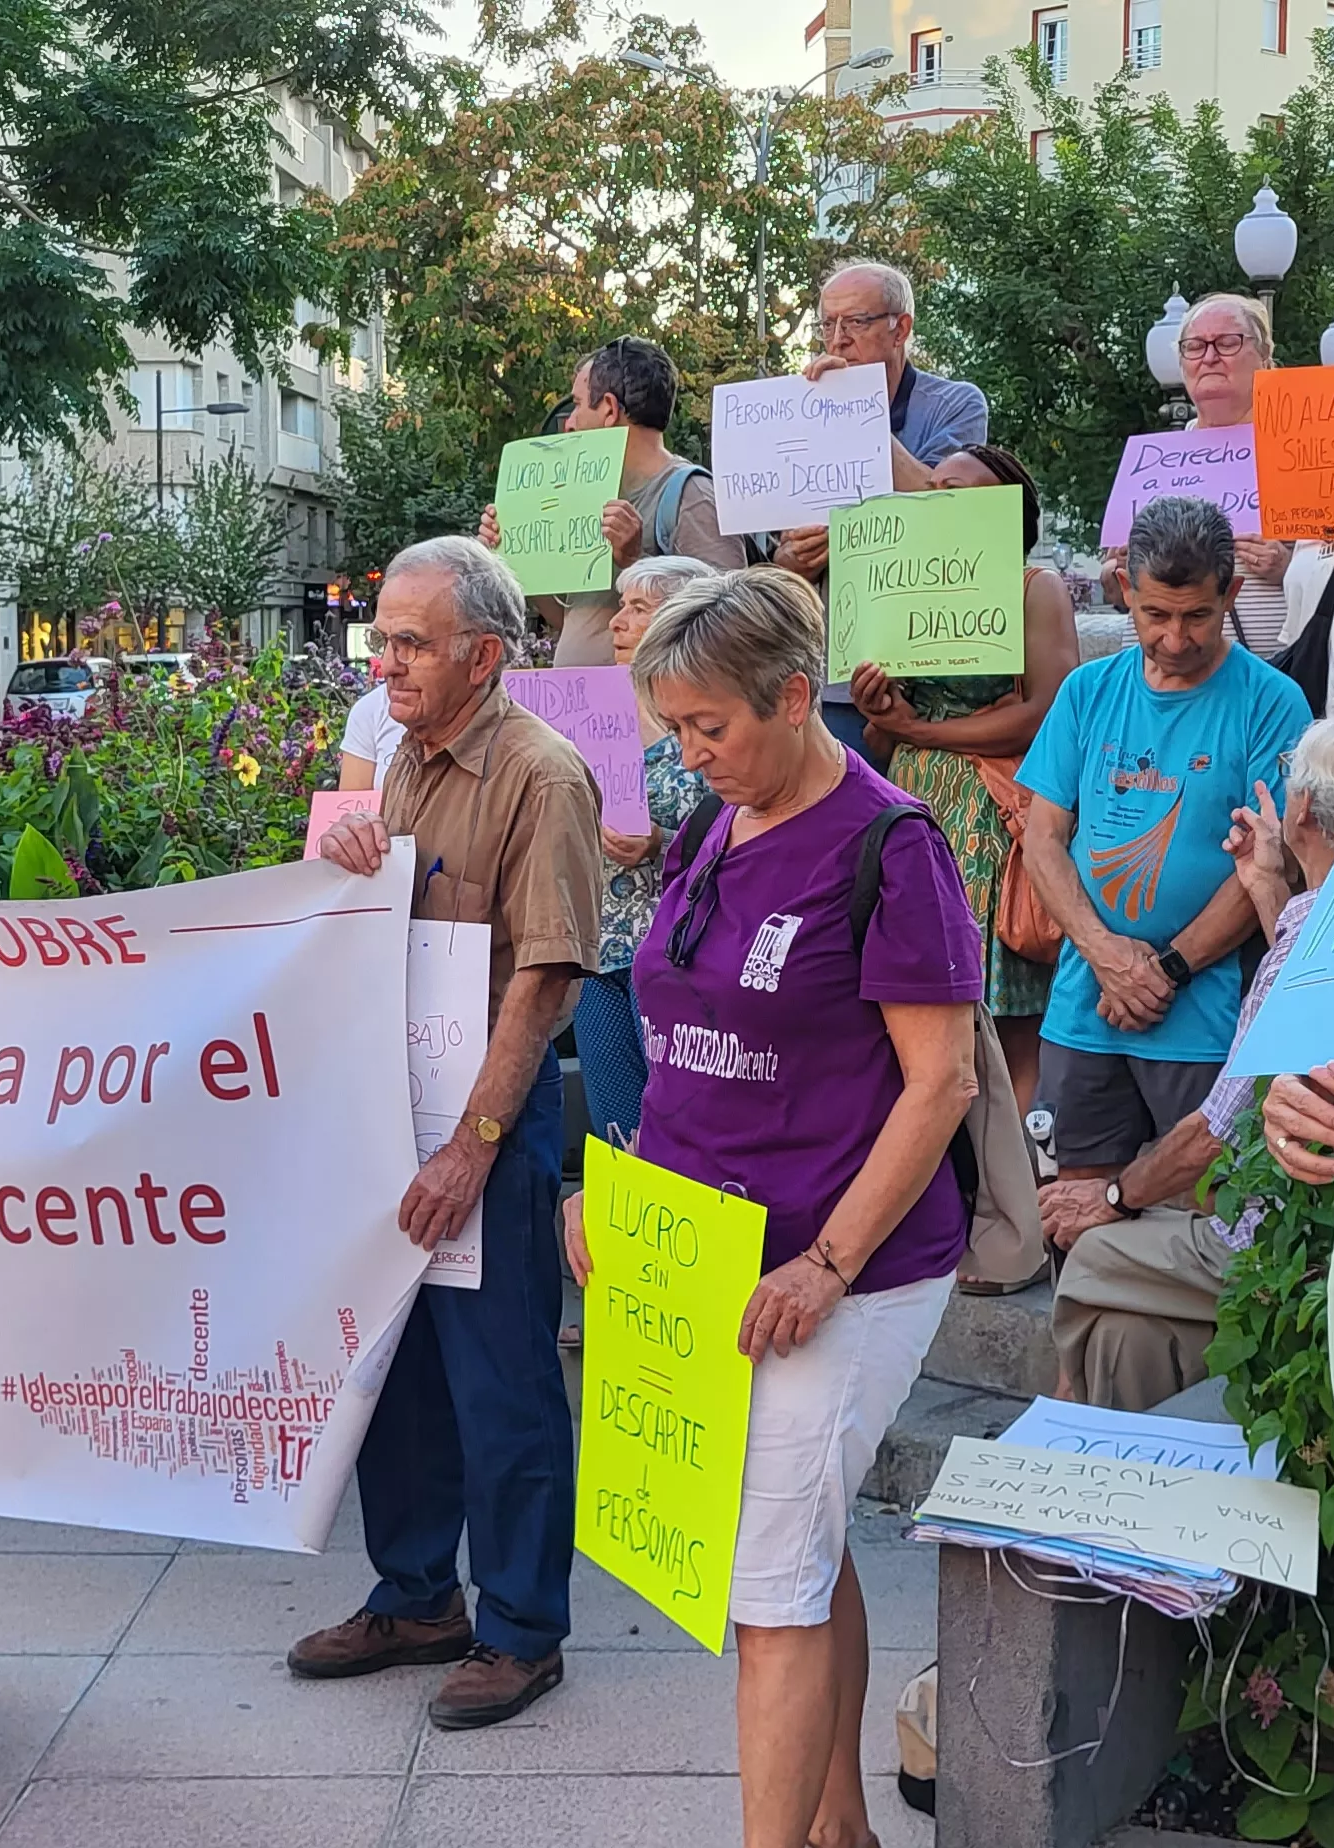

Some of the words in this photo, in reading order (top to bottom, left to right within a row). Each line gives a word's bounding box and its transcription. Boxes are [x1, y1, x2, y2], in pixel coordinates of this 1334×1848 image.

[725, 394, 794, 429] PERSONAS
[801, 387, 886, 427] COMPROMETIDAS
[1299, 396, 1313, 430] A
[506, 462, 545, 492] LUCRO
[574, 450, 611, 484] FRENO
[1130, 441, 1252, 476] Derecho
[722, 471, 780, 500] TRABAJO
[1143, 478, 1159, 490] a
[1171, 474, 1205, 487] una
[503, 519, 555, 555] DESCARTE
[839, 511, 905, 552] DIGNIDAD
[868, 548, 984, 592] INCLUSIÓN
[908, 605, 1007, 641] DIÁLOGO
[743, 957, 782, 976] HOAC
[407, 1014, 464, 1060] BAJO
[46, 1041, 171, 1126] por
[199, 1012, 281, 1101] el
[609, 1181, 699, 1267] LUCRO
[638, 1260, 669, 1290] SIN
[189, 1288, 209, 1382] decente
[608, 1285, 694, 1358] FRENO
[120, 1349, 138, 1384] social
[131, 1410, 173, 1434] España
[598, 1379, 706, 1471] DESCARTE
[231, 1429, 249, 1504] personas
[243, 1422, 267, 1490] dignidad
[1174, 1525, 1209, 1542] AL
[1217, 1504, 1285, 1532] PARA
[597, 1489, 705, 1601] PERSONAS
[1228, 1538, 1293, 1582] NO
